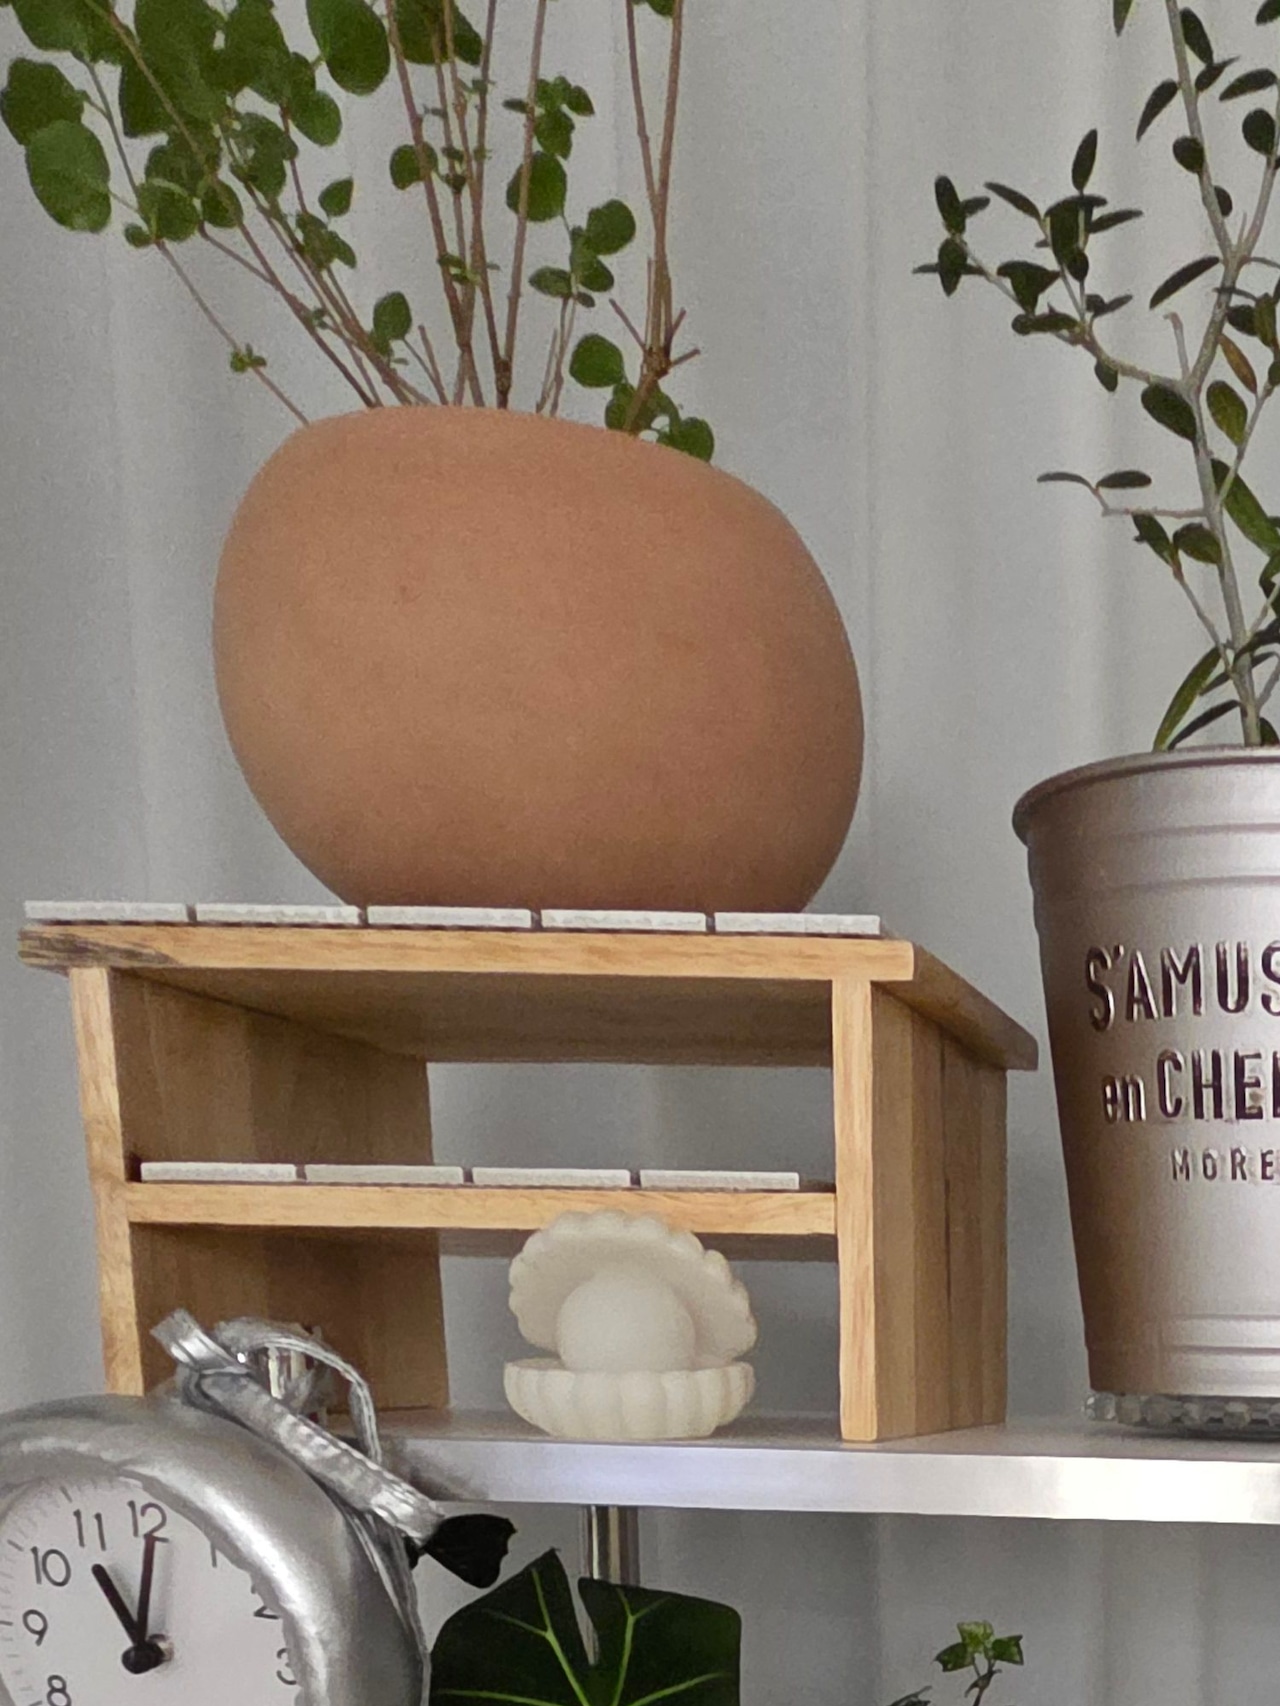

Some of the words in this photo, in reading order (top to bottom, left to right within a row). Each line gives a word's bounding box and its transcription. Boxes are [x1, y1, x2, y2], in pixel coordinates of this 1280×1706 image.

[1101, 1074, 1147, 1124] en
[73, 1508, 107, 1551] 11
[127, 1500, 170, 1544] 12
[30, 1546, 72, 1587] 10
[22, 1609, 49, 1647] 9
